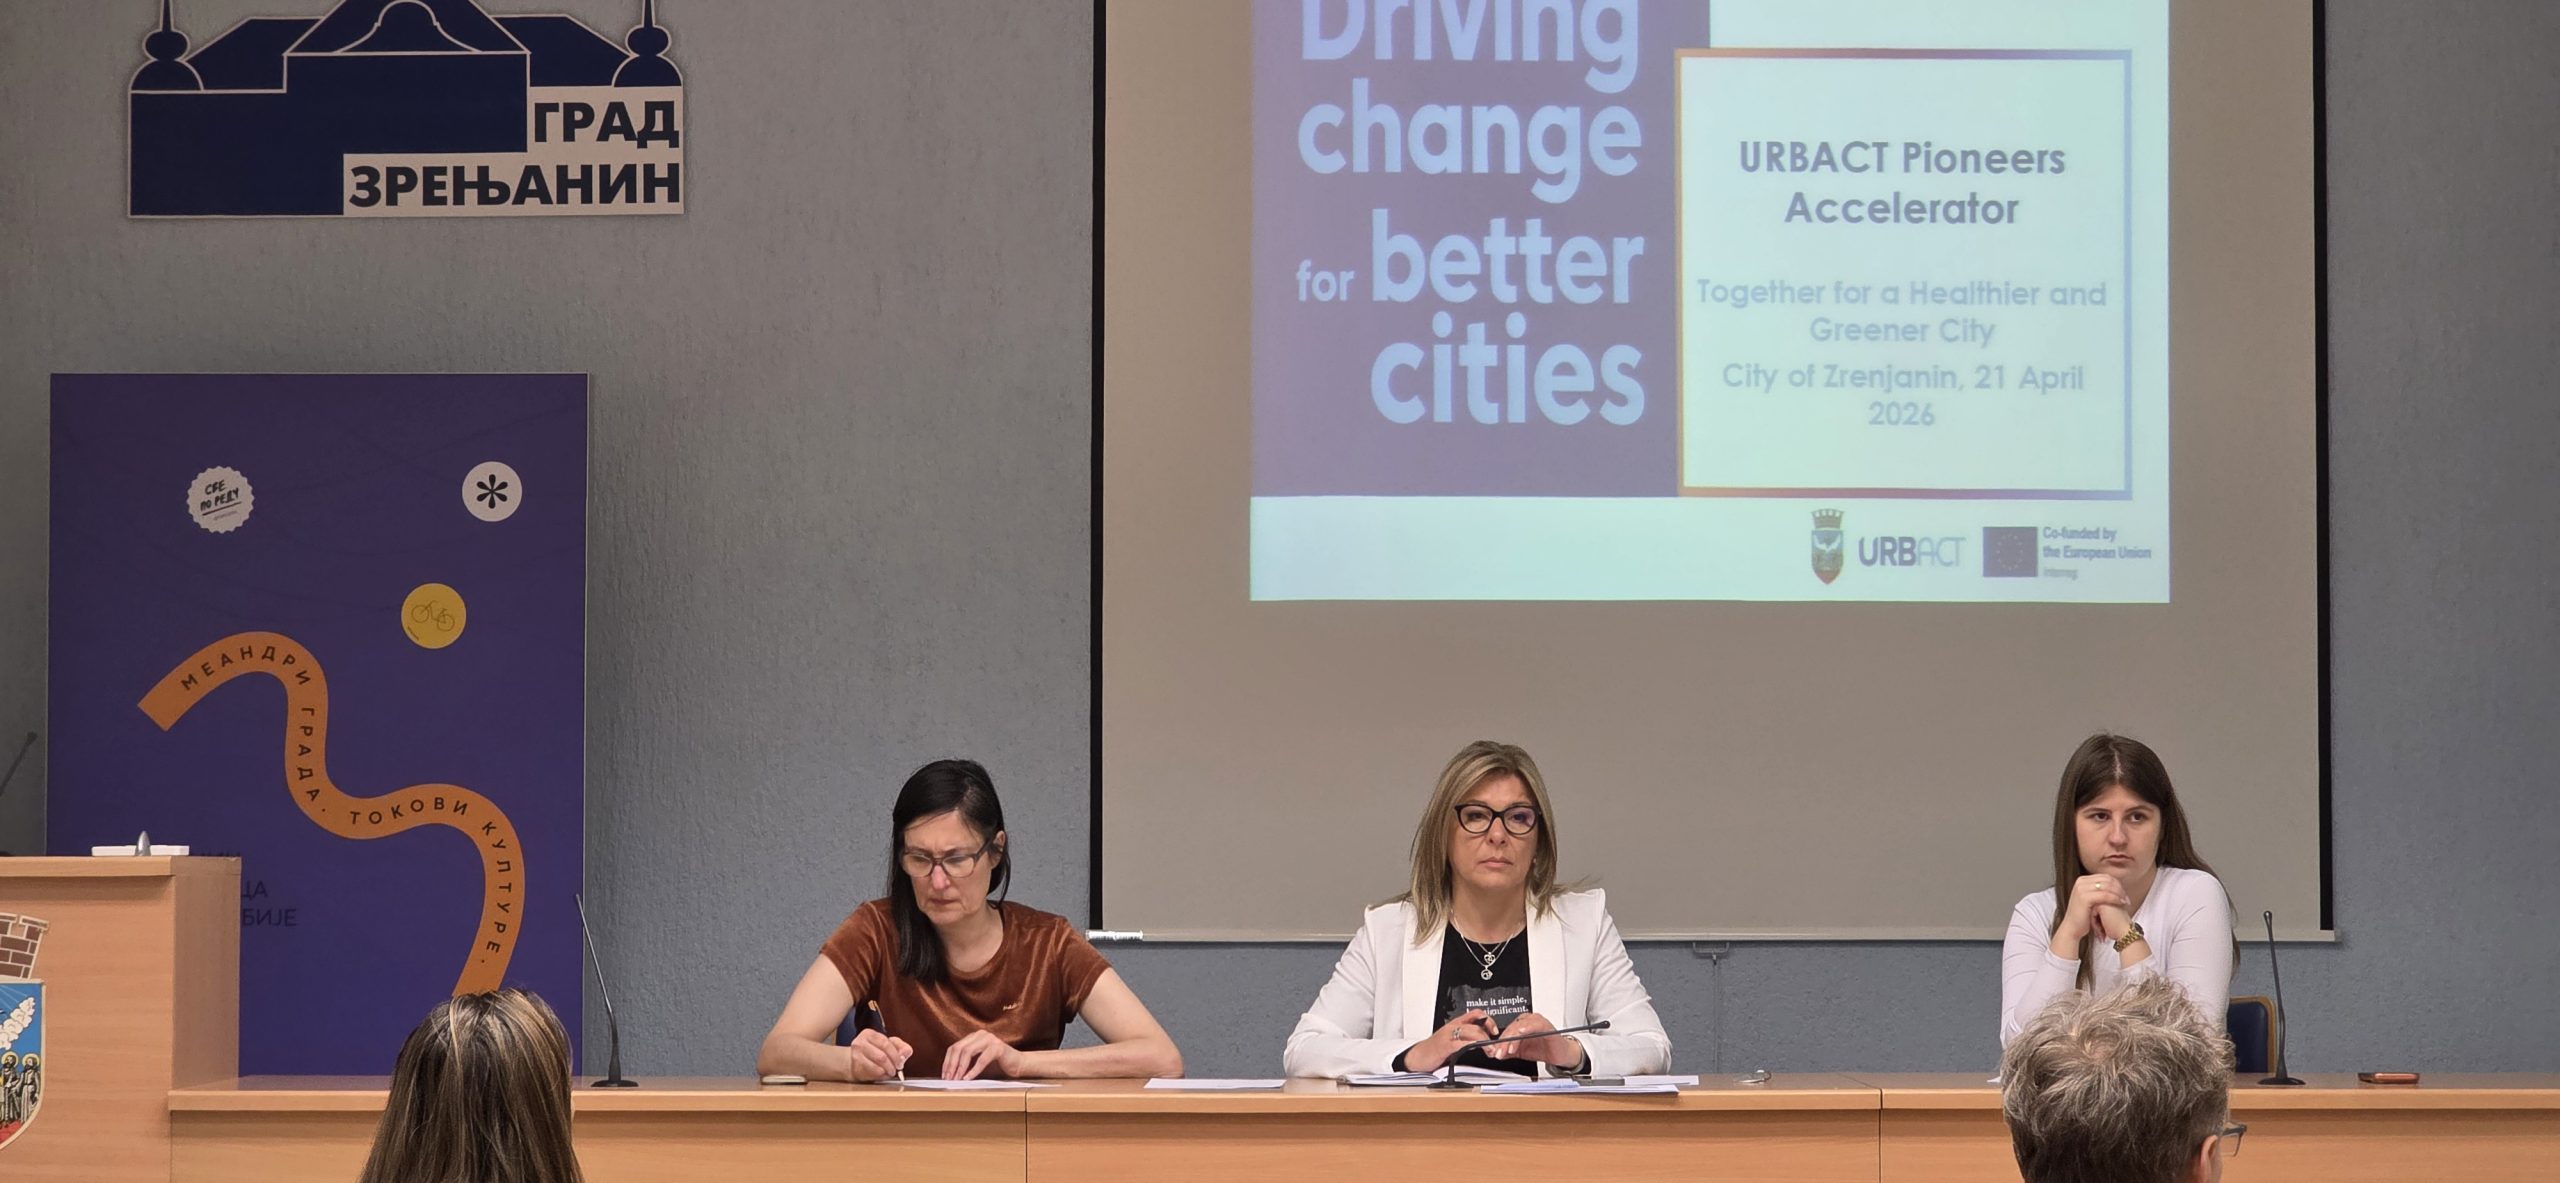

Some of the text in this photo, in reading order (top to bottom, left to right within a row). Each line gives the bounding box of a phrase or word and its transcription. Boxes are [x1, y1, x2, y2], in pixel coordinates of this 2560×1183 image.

[1302, 0, 1640, 93] Driving
[534, 101, 680, 149] ГРАД
[1299, 77, 1642, 204] change
[1740, 140, 2066, 174] URBACT Pioneers
[349, 163, 680, 208] ЗРЕЊАНИН
[1784, 191, 2020, 225] Accelerator
[1296, 208, 1645, 304] for better
[1697, 279, 2108, 309] Together for a Healthier and
[1809, 317, 1996, 349] Greener City
[1370, 310, 1646, 426] cities
[1722, 363, 2085, 395] City of Zrenjanin, 21 April
[1868, 401, 1936, 427] 2026
[1859, 535, 1967, 567] URBACT
[2043, 526, 2117, 543] Co-funded by
[2063, 545, 2115, 561] European
[2118, 546, 2152, 559] Union
[180, 645, 311, 690] МЕАНДРИ
[350, 797, 468, 825] ТОКОВИ
[241, 908, 297, 928] БИЈЕ
[1466, 995, 1528, 1007] make it simple,
